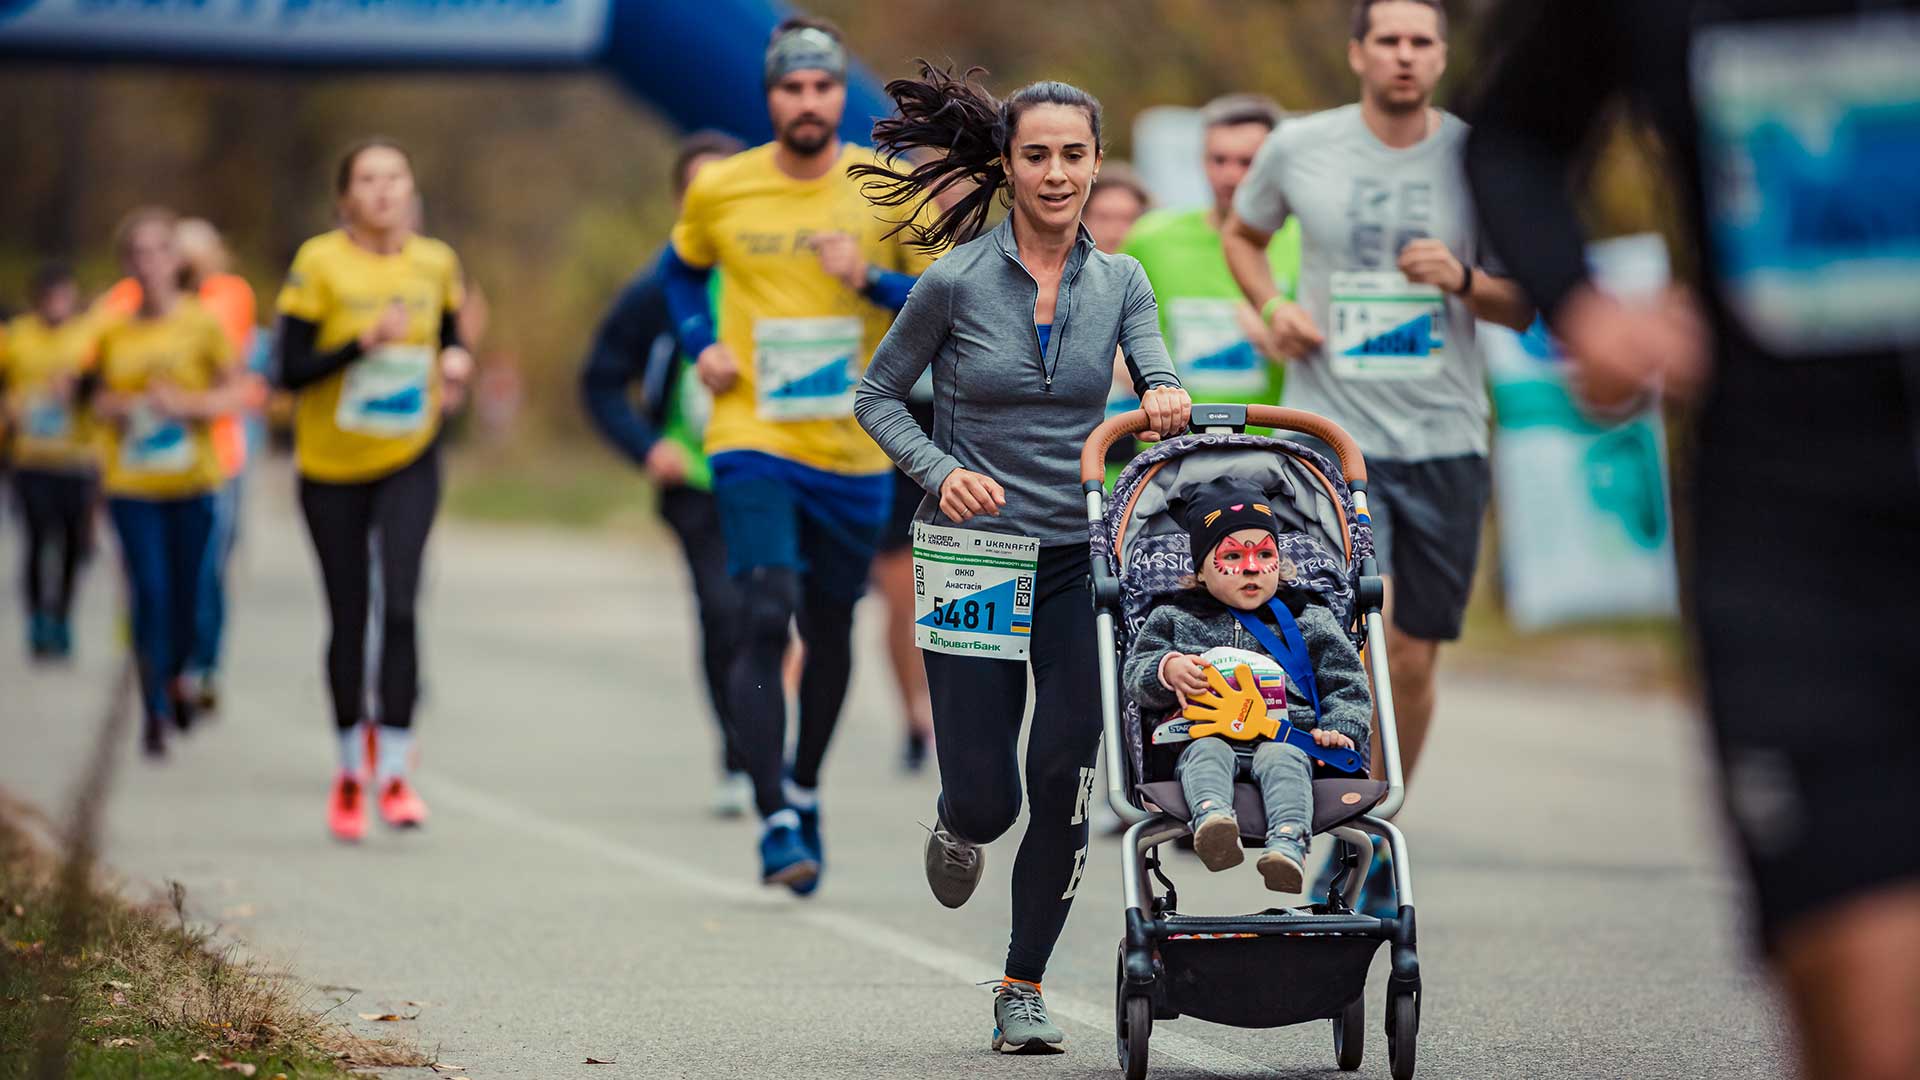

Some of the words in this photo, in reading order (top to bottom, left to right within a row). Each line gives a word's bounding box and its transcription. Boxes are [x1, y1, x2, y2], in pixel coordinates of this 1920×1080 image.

[927, 533, 954, 543] UNDER
[927, 538, 961, 549] ARMOUR
[985, 540, 1036, 552] UKRNAFTA
[945, 580, 982, 591] Анастасія
[933, 596, 996, 631] 5481
[937, 635, 1001, 652] ПриватБанк
